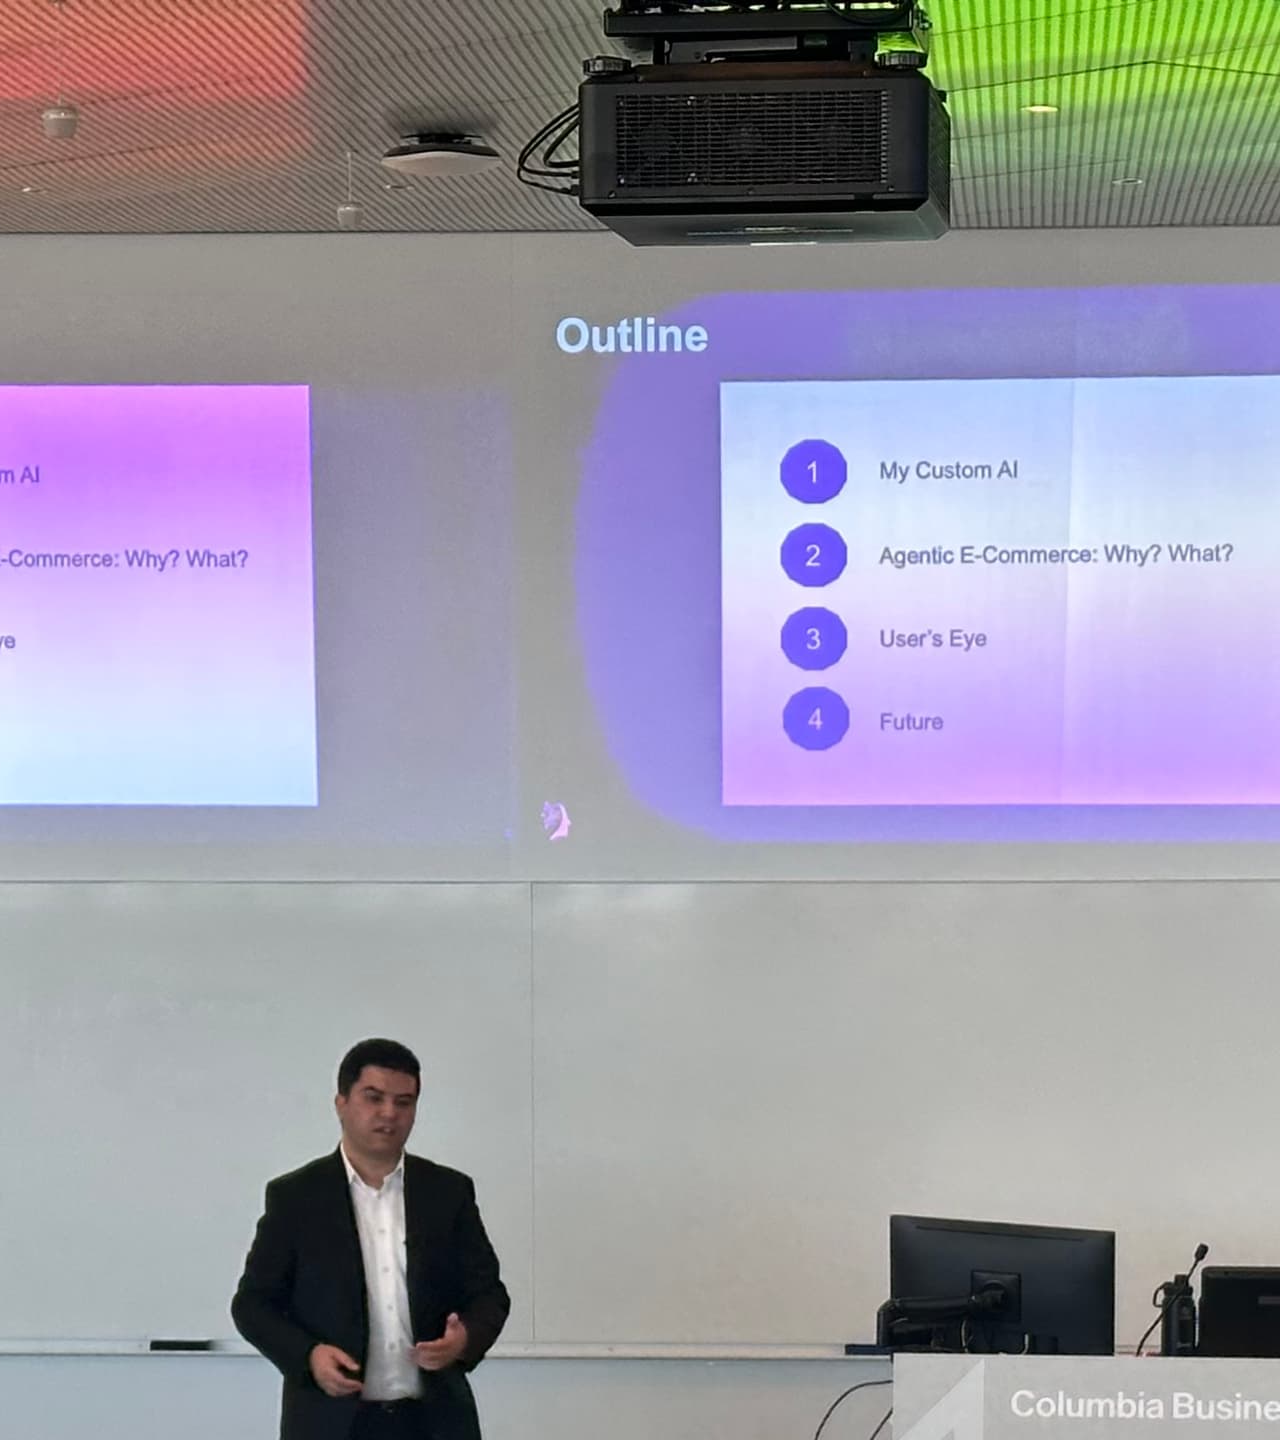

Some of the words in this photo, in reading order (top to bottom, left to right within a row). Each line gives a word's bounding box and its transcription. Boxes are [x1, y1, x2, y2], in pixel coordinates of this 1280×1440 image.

[556, 316, 709, 354] Outline
[19, 465, 41, 484] AI
[807, 460, 817, 484] 1
[879, 460, 911, 485] My
[915, 460, 993, 480] Custom
[996, 459, 1018, 479] AI
[124, 549, 181, 573] Why?
[185, 549, 249, 569] What?
[805, 544, 821, 567] 2
[878, 545, 955, 570] Agentic
[960, 544, 1099, 565] E-Commerce:
[1103, 543, 1162, 568] Why?
[1167, 543, 1234, 563] What?
[806, 627, 821, 650] 3
[879, 628, 944, 649] User's
[949, 628, 988, 653] Eye
[807, 707, 824, 731] 4
[879, 711, 945, 732] Future
[1010, 1389, 1164, 1420] Columbia
